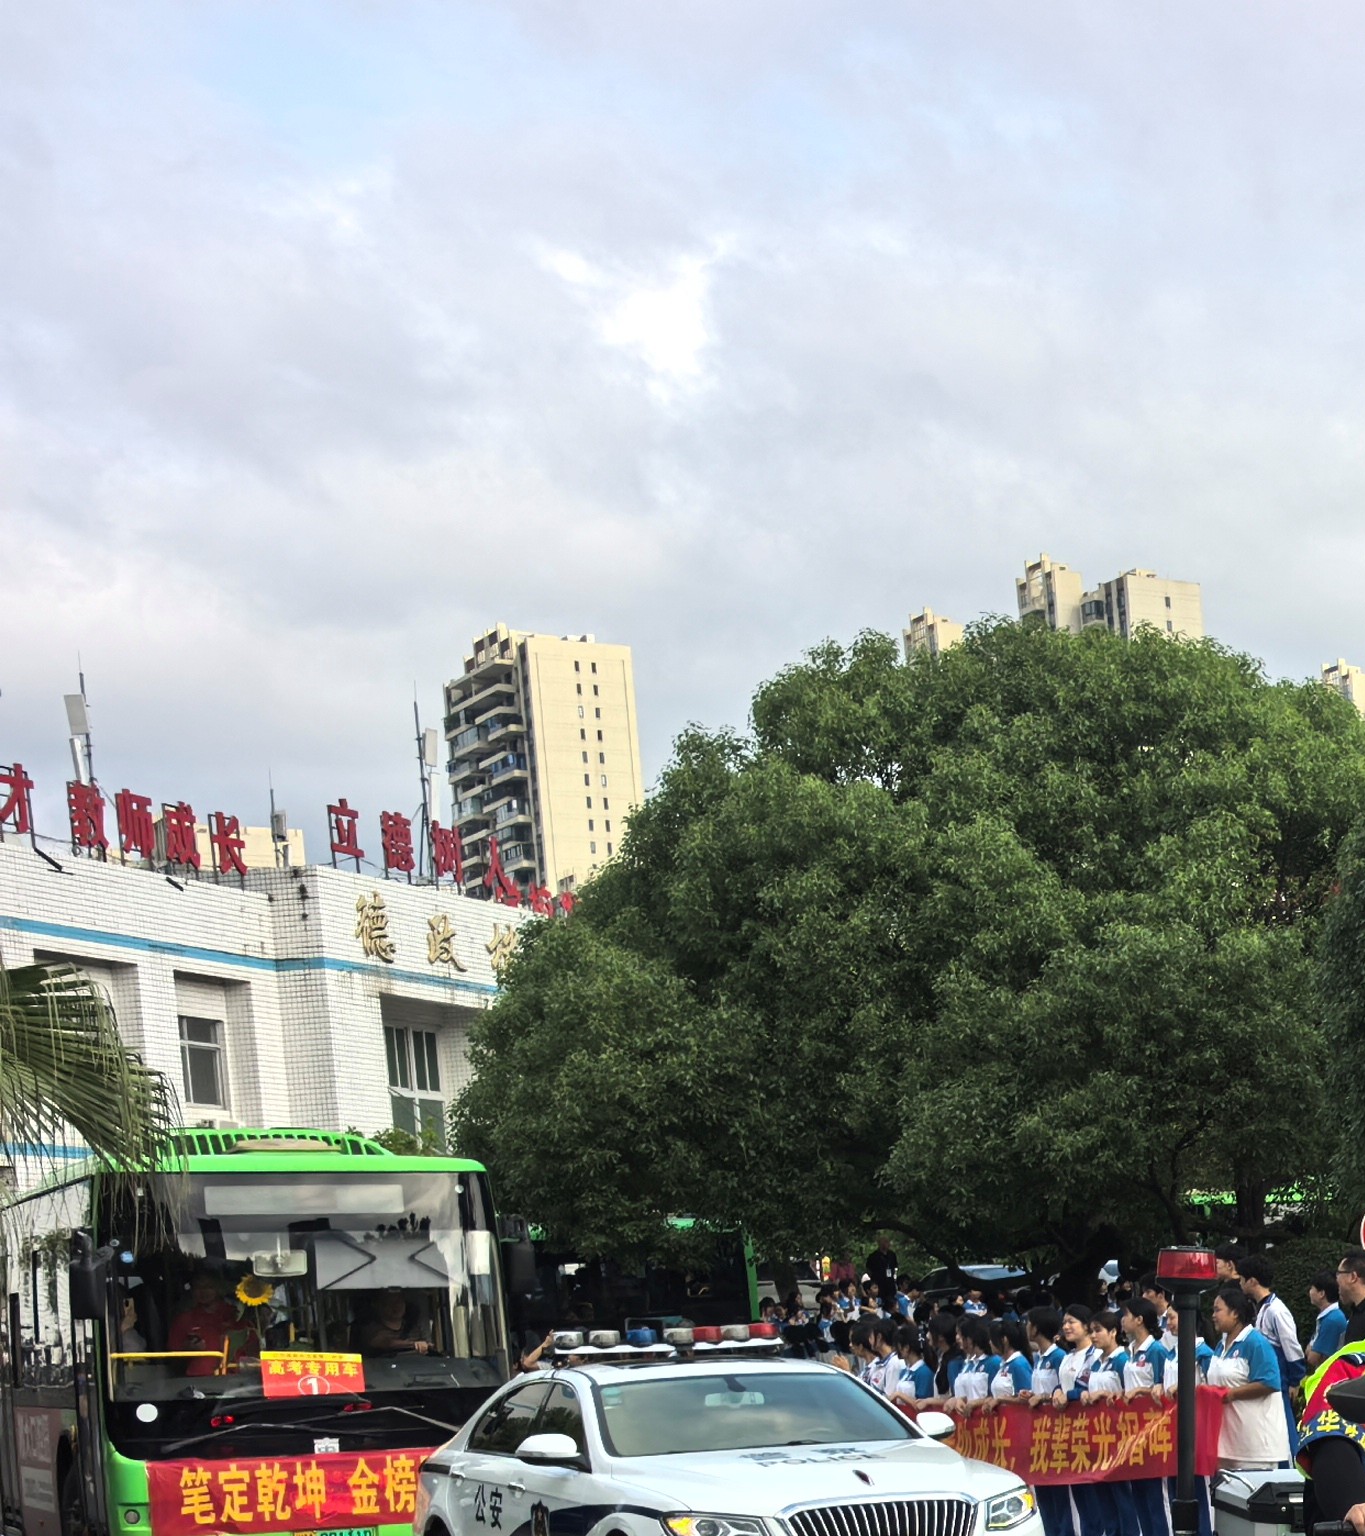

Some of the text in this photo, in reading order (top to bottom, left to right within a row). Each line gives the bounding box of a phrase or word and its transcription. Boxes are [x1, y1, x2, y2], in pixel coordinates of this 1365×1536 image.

[69, 779, 248, 876] 教师成长
[327, 798, 522, 898] 立德树人
[268, 1360, 359, 1377] 高考专用车
[179, 1453, 428, 1525] 笔定乾坤 金榜
[474, 1483, 503, 1531] 公安
